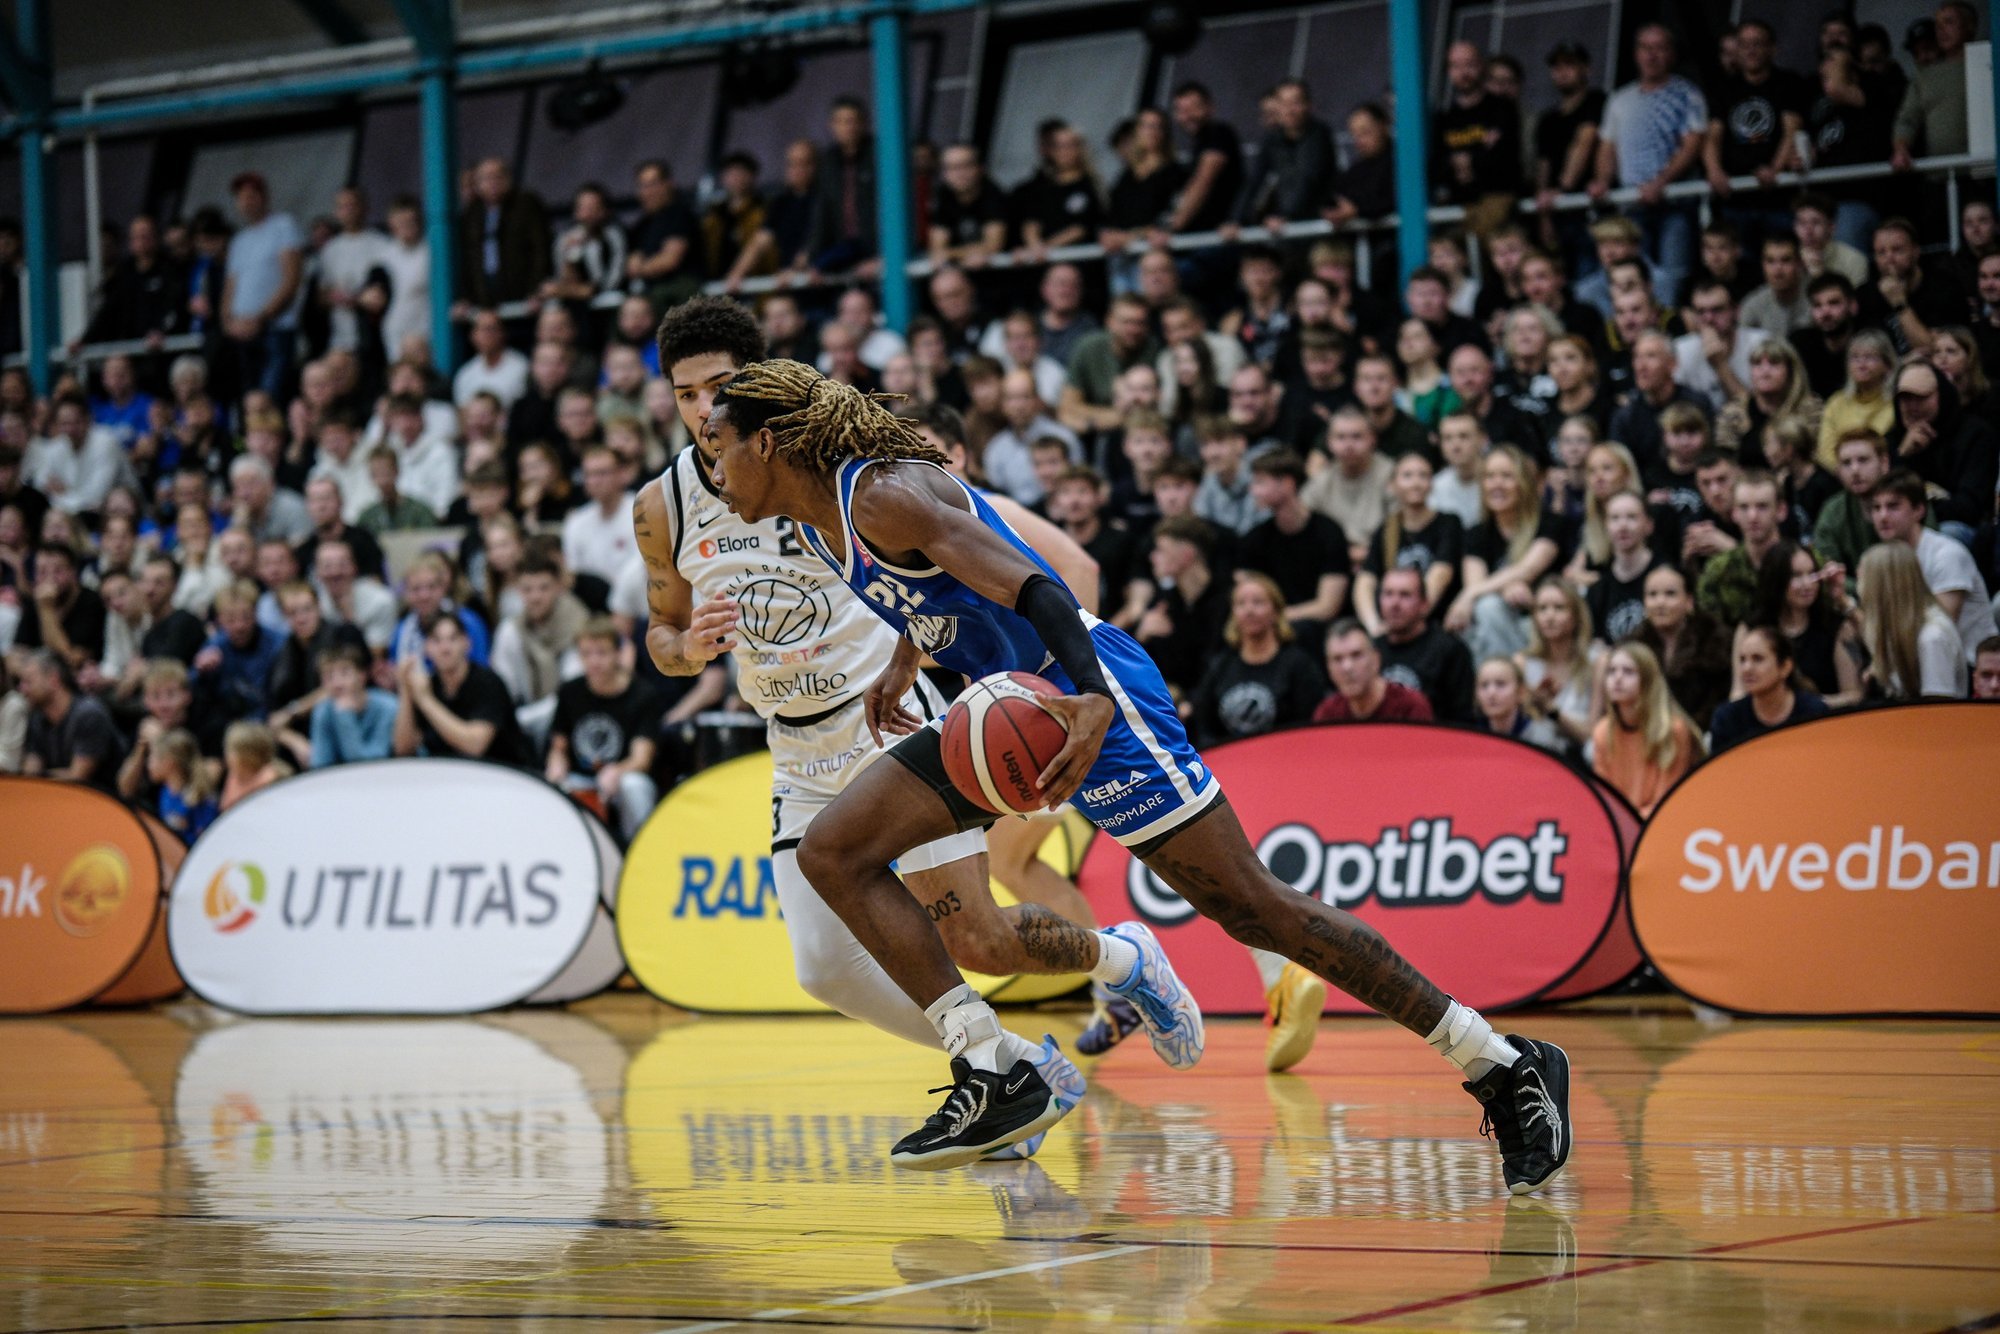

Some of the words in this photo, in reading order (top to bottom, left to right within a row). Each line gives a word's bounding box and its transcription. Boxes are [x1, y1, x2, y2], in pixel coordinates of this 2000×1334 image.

[717, 535, 760, 553] Elora
[775, 516, 817, 556] 2
[726, 568, 754, 596] EILA
[762, 565, 822, 593] BASKET
[864, 573, 926, 613] 22
[751, 648, 809, 665] COOLBET
[756, 672, 847, 698] CityAlko
[807, 747, 864, 777] UTILITAS
[1002, 750, 1034, 802] molten
[1081, 770, 1148, 803] KEILA
[1255, 817, 1567, 909] Optibet
[281, 862, 562, 928] UTILITAS
[926, 890, 962, 922] 003
